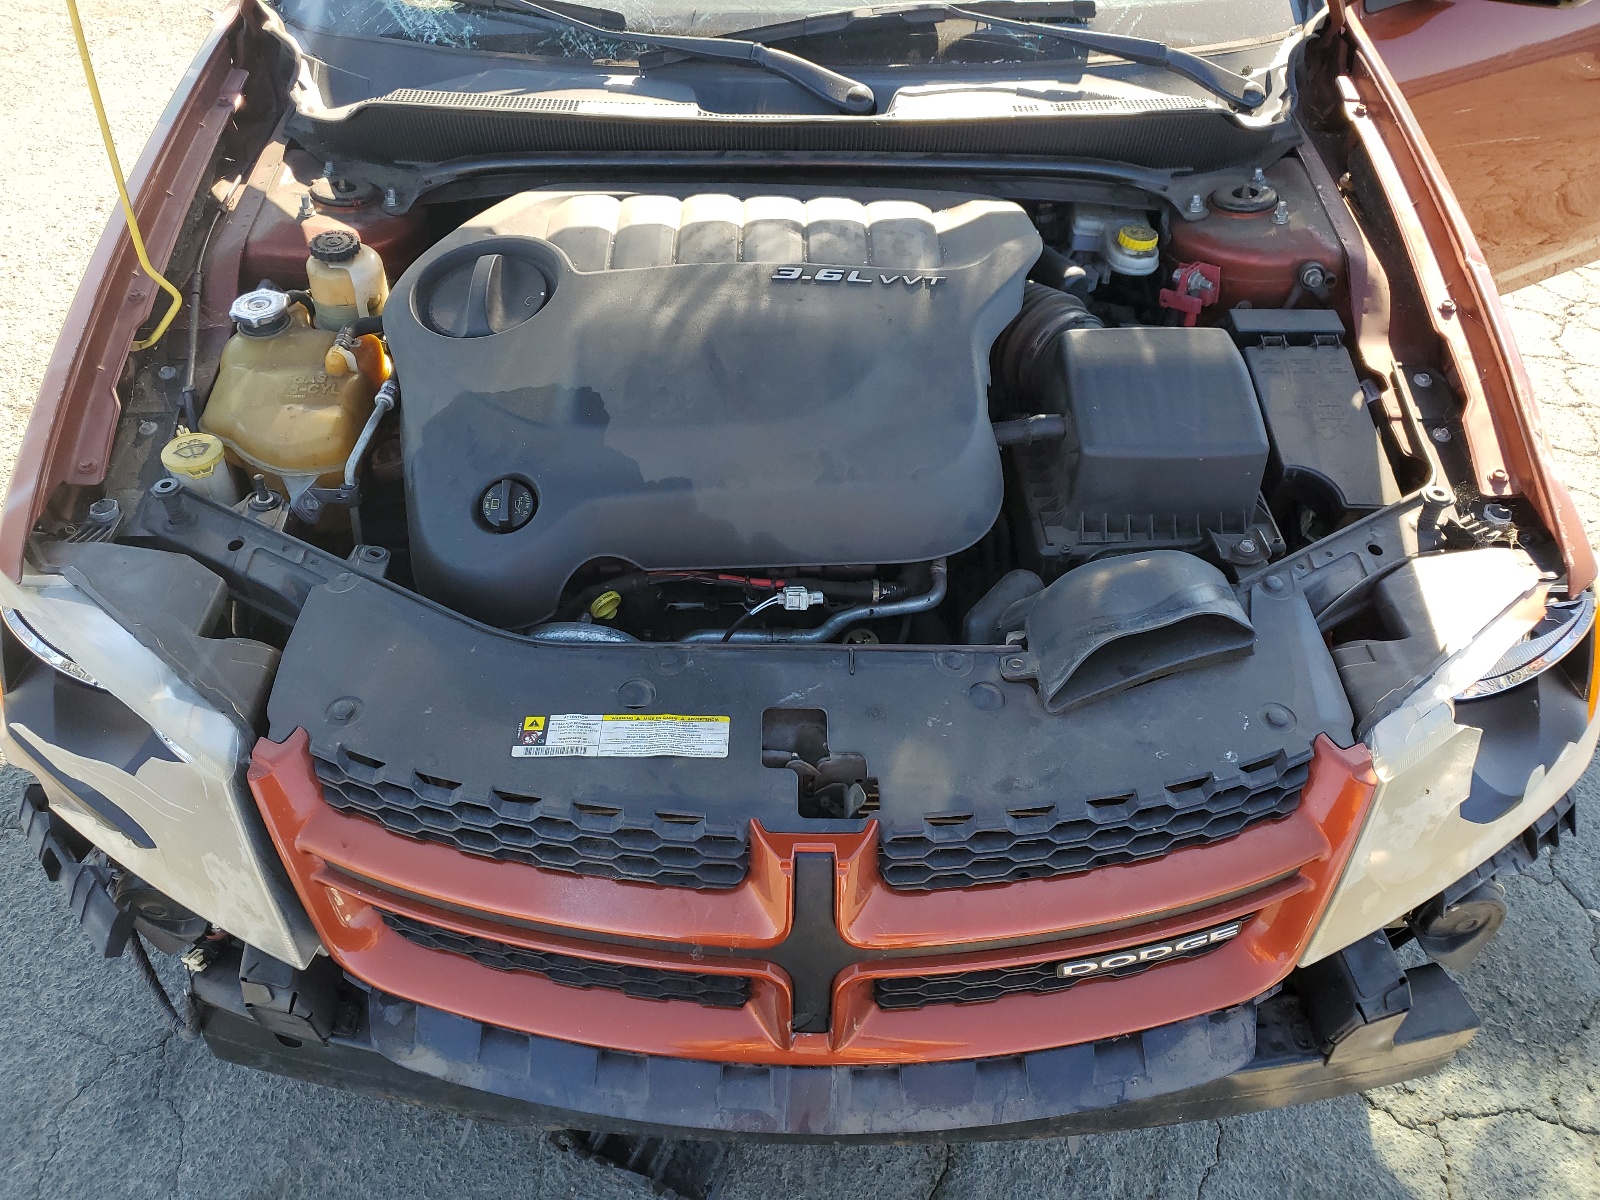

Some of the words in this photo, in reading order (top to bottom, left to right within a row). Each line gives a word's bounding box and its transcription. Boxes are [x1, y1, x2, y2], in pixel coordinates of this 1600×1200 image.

[771, 267, 873, 284] 3.6L
[879, 274, 947, 286] VVT
[1062, 923, 1239, 977] DODGE
